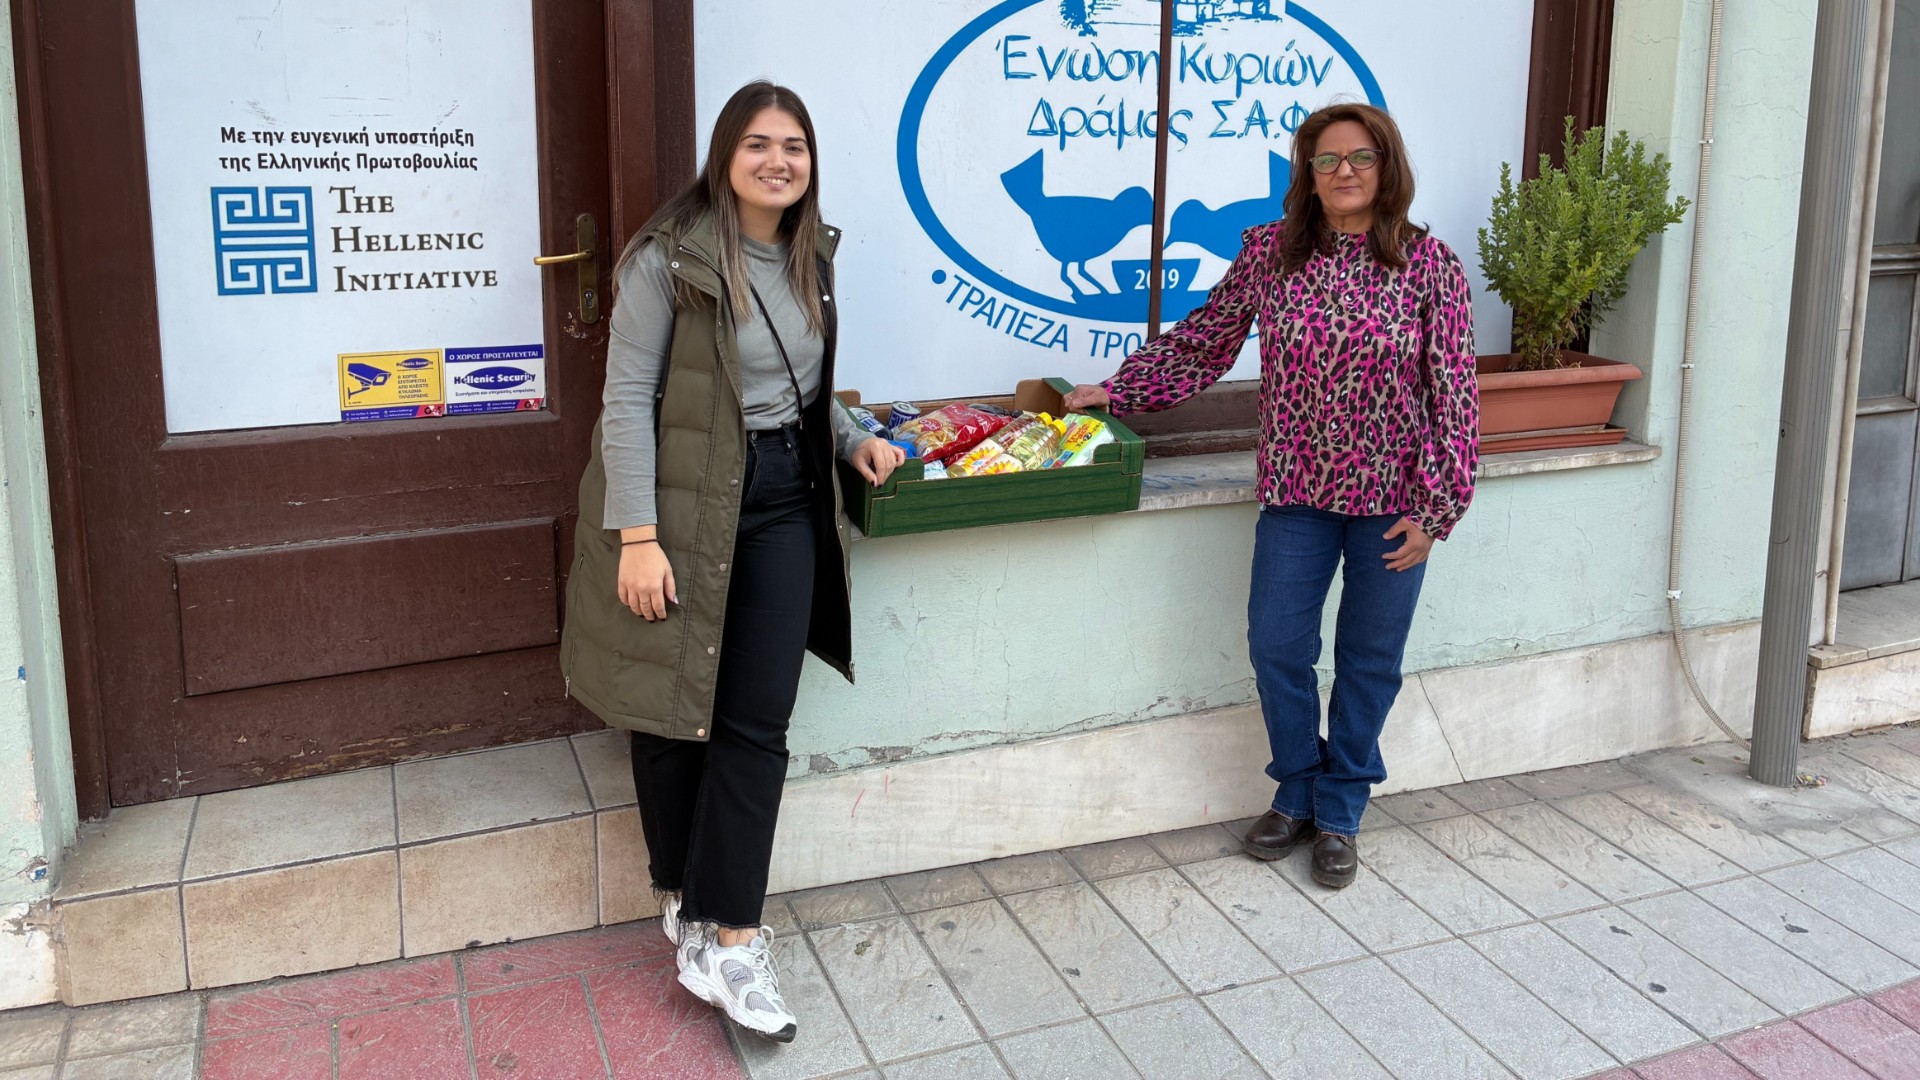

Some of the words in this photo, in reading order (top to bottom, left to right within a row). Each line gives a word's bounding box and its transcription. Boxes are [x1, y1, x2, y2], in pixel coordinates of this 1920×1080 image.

[996, 35, 1160, 92] Ένωση
[1179, 40, 1334, 98] Κυριών
[220, 126, 246, 144] Με
[252, 130, 284, 146] την
[290, 126, 369, 148] ευγενική
[374, 127, 474, 148] υποστήριξη
[219, 156, 251, 172] της
[257, 151, 351, 172] Ελληνικής
[356, 152, 478, 173] Πρωτοβουλίας
[945, 274, 1069, 352] ΤΡΑΠΕΖΑ
[1088, 329, 1143, 359] ΤΡΟ
[482, 351, 539, 360] ΠΡΟΣΤΑΤΕΥΕΤΑΙ
[454, 374, 495, 384] Hellenic
[497, 372, 537, 382] Security
